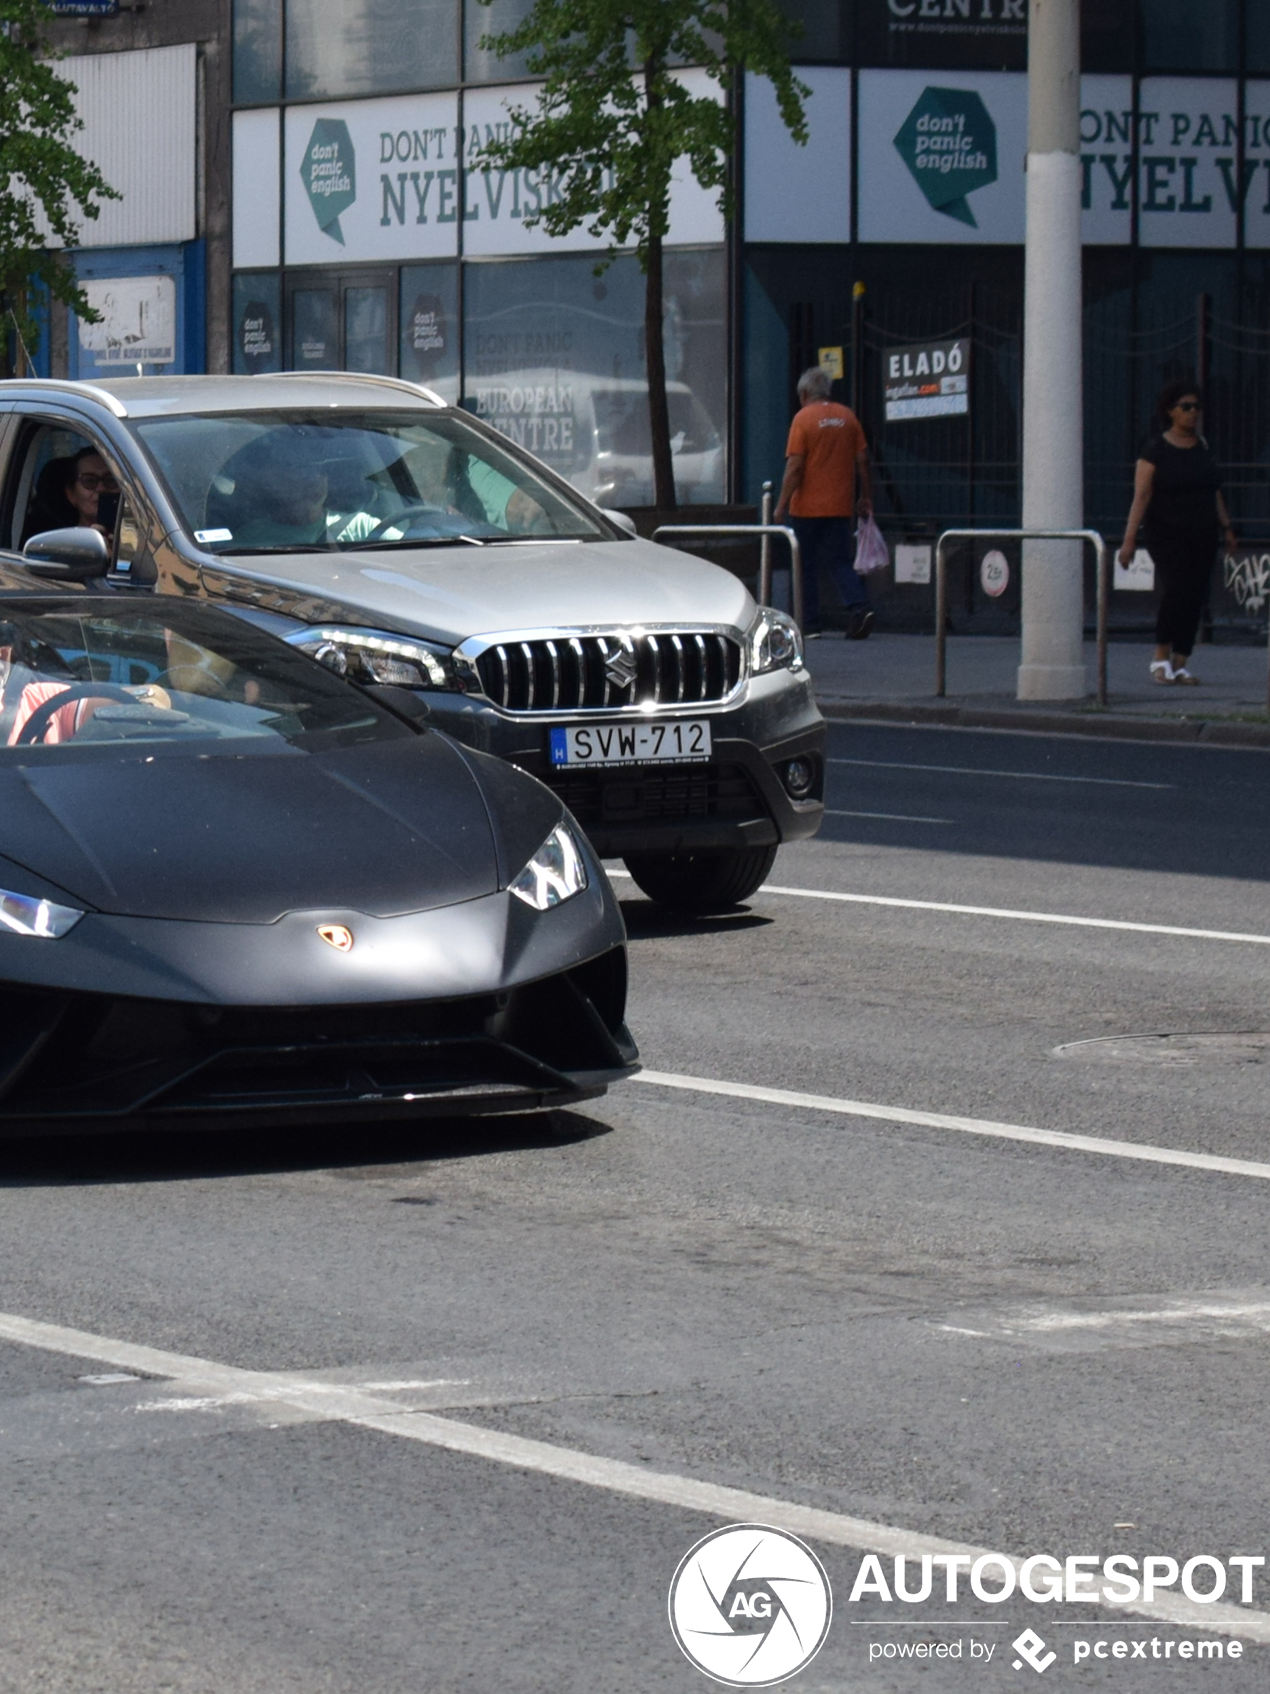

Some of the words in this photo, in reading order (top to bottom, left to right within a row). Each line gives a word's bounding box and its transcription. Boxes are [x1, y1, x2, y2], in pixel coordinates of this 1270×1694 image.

[916, 113, 965, 132] don't
[311, 142, 338, 159] don't
[380, 128, 447, 164] DON'T
[915, 133, 973, 153] panic
[311, 159, 343, 180] panic
[916, 151, 987, 173] english
[311, 175, 350, 196] english
[889, 342, 963, 378] ELADÓ
[476, 386, 573, 415] EUROPEAN
[574, 724, 705, 759] SVW-712
[555, 749, 563, 760] H
